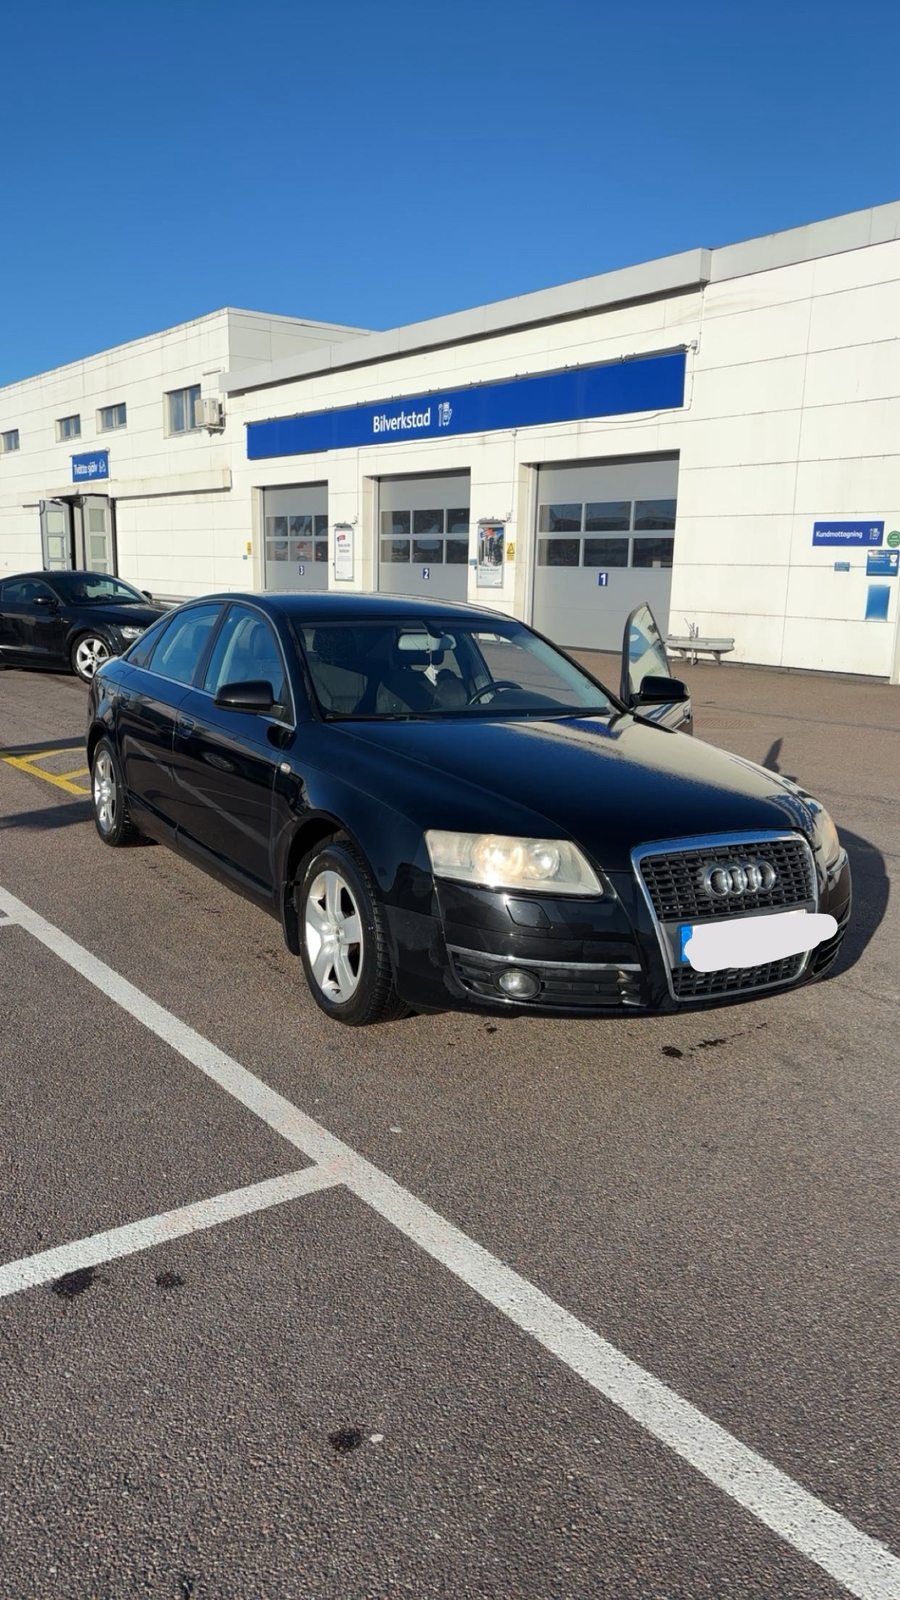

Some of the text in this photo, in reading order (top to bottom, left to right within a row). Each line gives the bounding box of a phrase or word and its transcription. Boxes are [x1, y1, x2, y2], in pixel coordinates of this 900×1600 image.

[373, 407, 431, 433] Bilverkstad
[815, 530, 863, 539] Kundmottagning
[600, 573, 606, 586] 1
